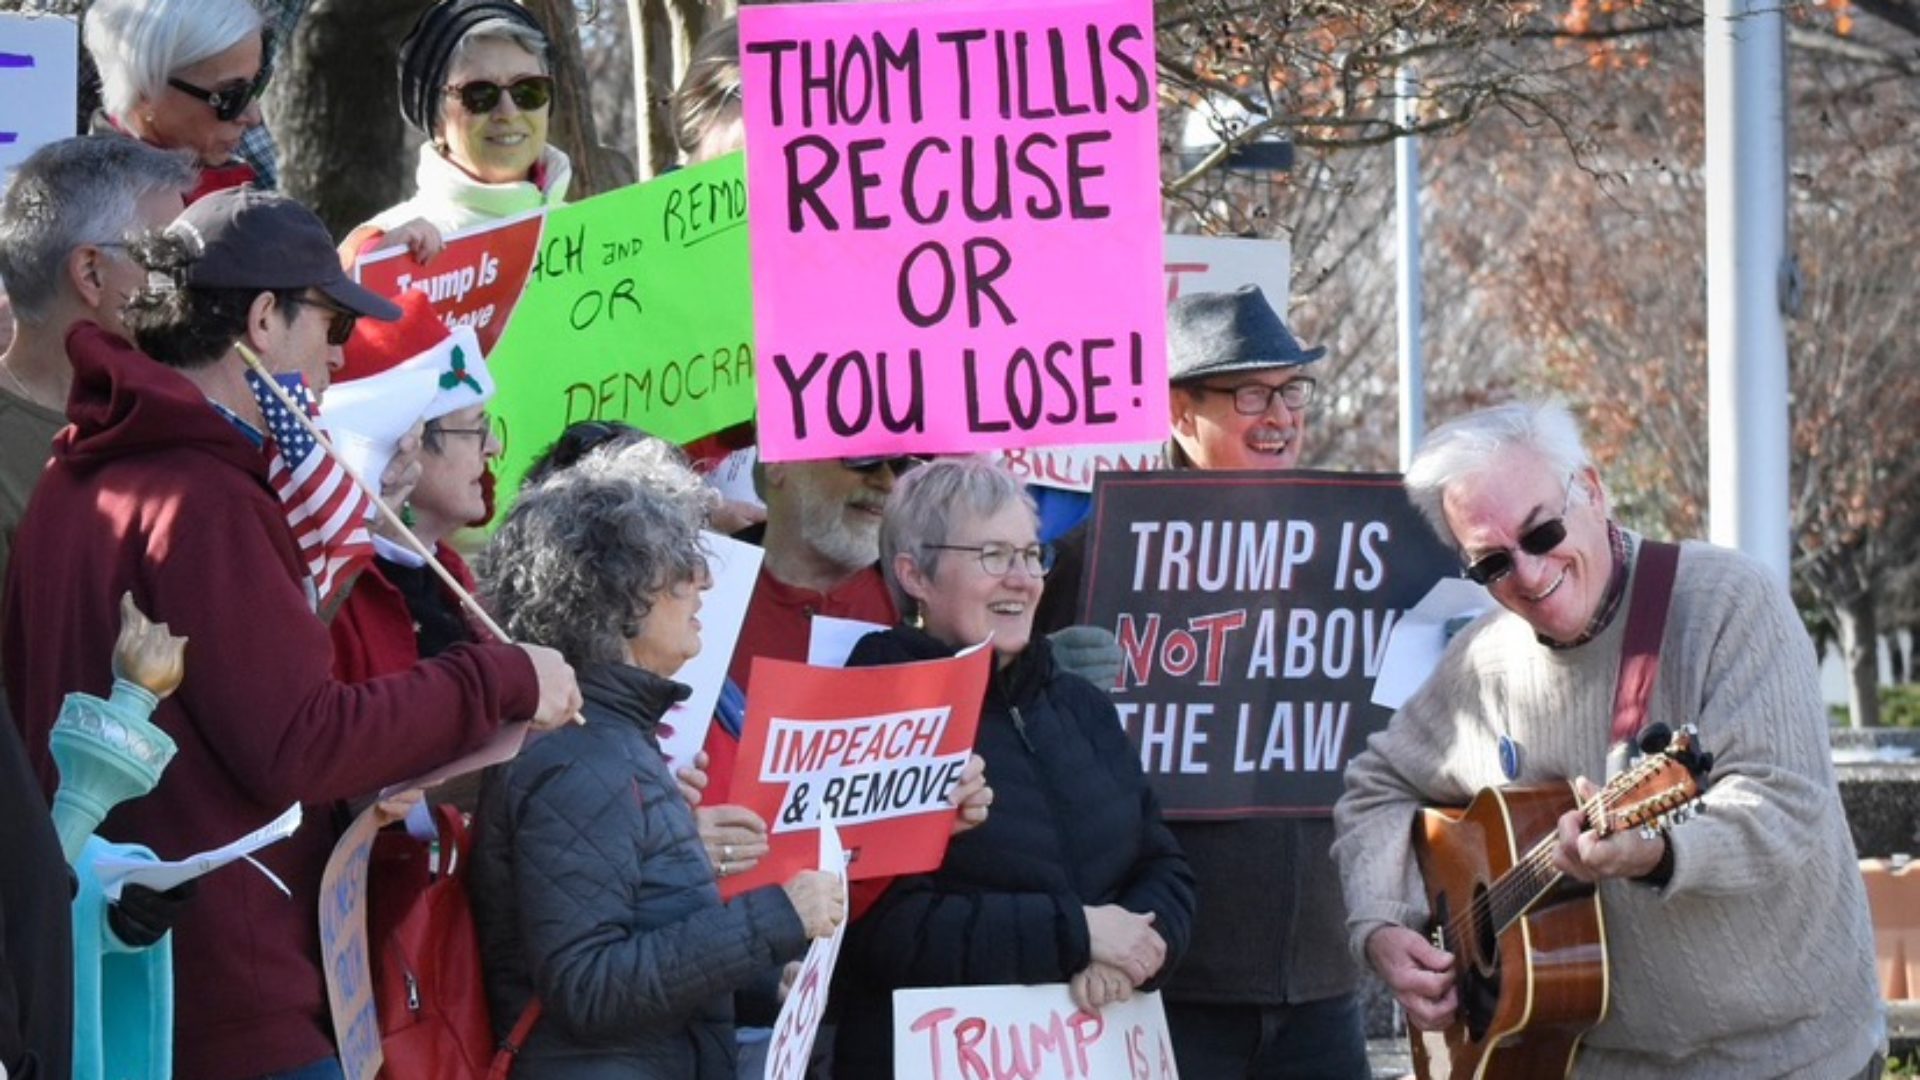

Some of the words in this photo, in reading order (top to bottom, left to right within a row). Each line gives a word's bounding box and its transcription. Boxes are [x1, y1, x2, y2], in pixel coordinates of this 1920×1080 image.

[746, 27, 923, 127] THOM
[936, 23, 1150, 120] TILLIS
[783, 130, 1112, 233] RECUSE
[476, 250, 499, 287] Is
[569, 278, 642, 330] OR
[897, 237, 1017, 328] OR
[772, 348, 926, 440] YOU
[963, 331, 1144, 434] LOSE!
[1130, 520, 1317, 592] TRUMP
[1333, 520, 1391, 592] IS
[1246, 607, 1412, 680] ABOV
[769, 715, 942, 774] IMPEACH
[782, 782, 811, 825] &
[816, 759, 966, 820] REMOVE
[910, 1006, 1105, 1080] TRUMP
[1124, 1024, 1151, 1080] IS
